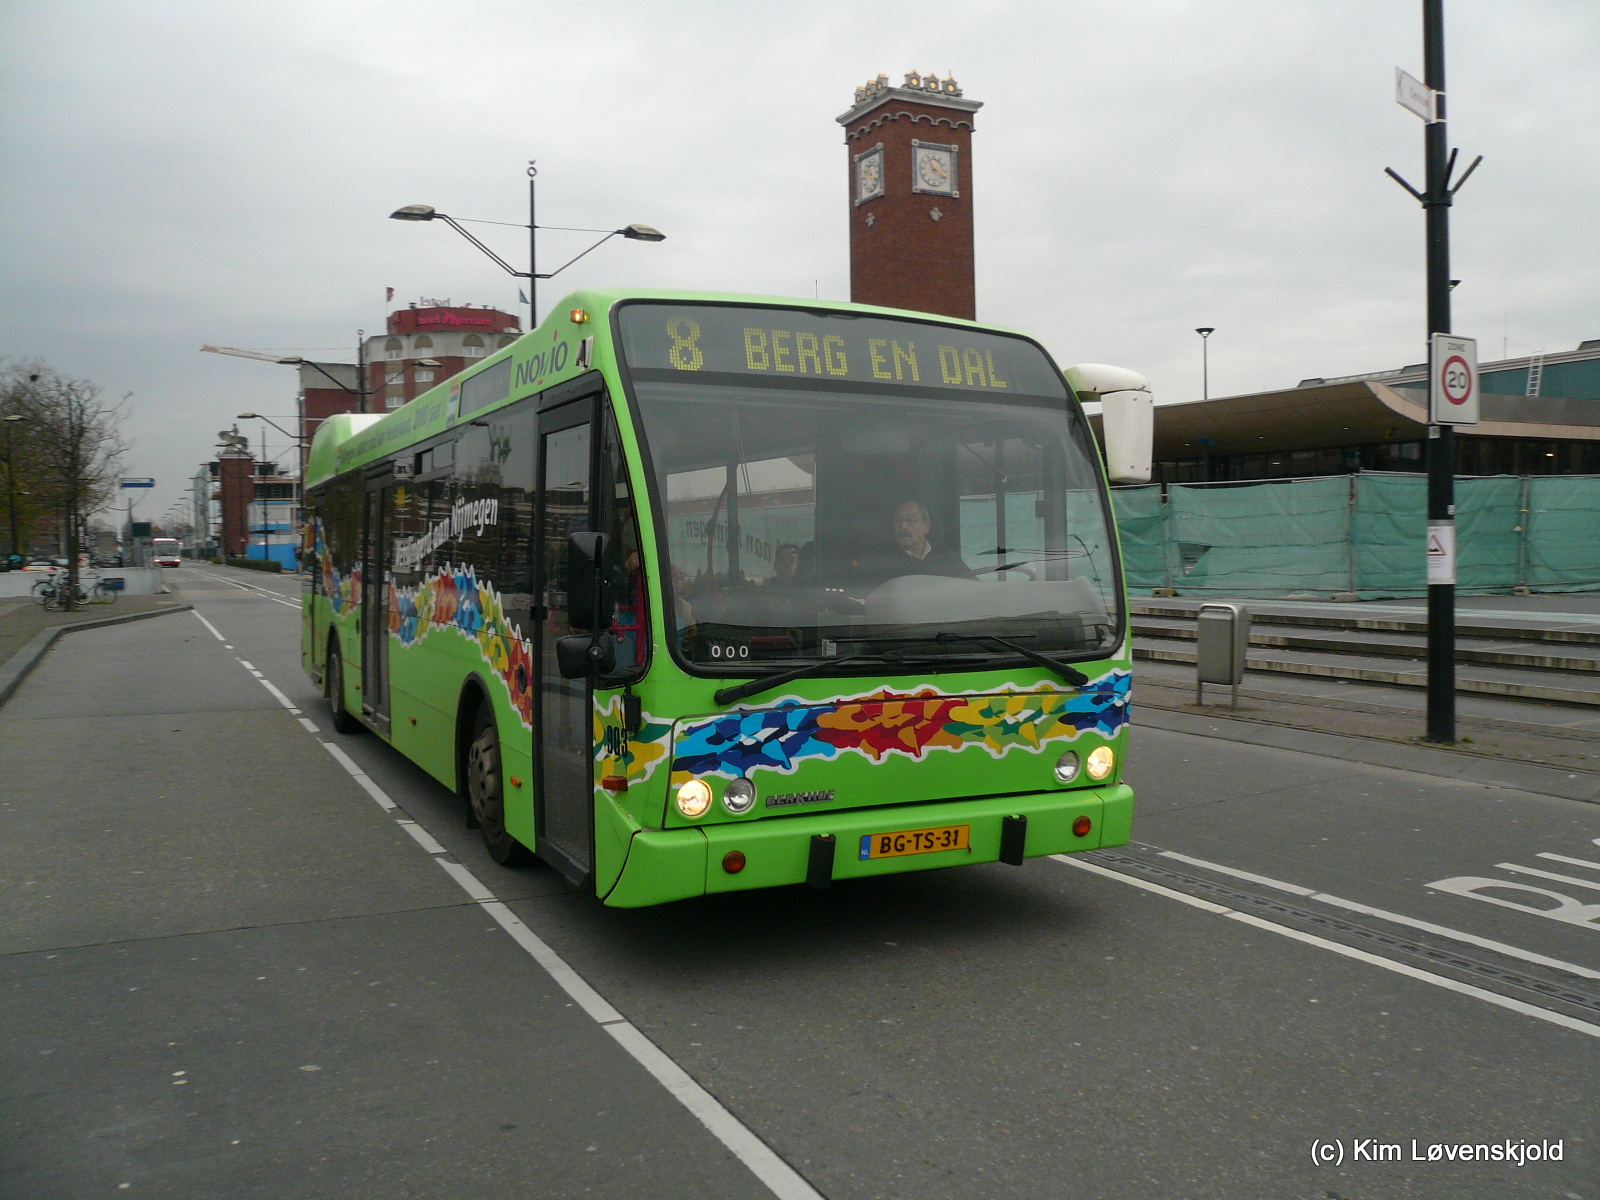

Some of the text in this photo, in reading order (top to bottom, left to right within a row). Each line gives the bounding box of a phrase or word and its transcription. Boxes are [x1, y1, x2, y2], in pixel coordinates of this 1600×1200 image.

[667, 315, 1007, 388] 8 BERG EN DAL
[1447, 342, 1466, 352] ZONE
[1448, 370, 1466, 389] 20
[450, 496, 499, 543] Nijmegen
[879, 828, 960, 854] BG-TS-31
